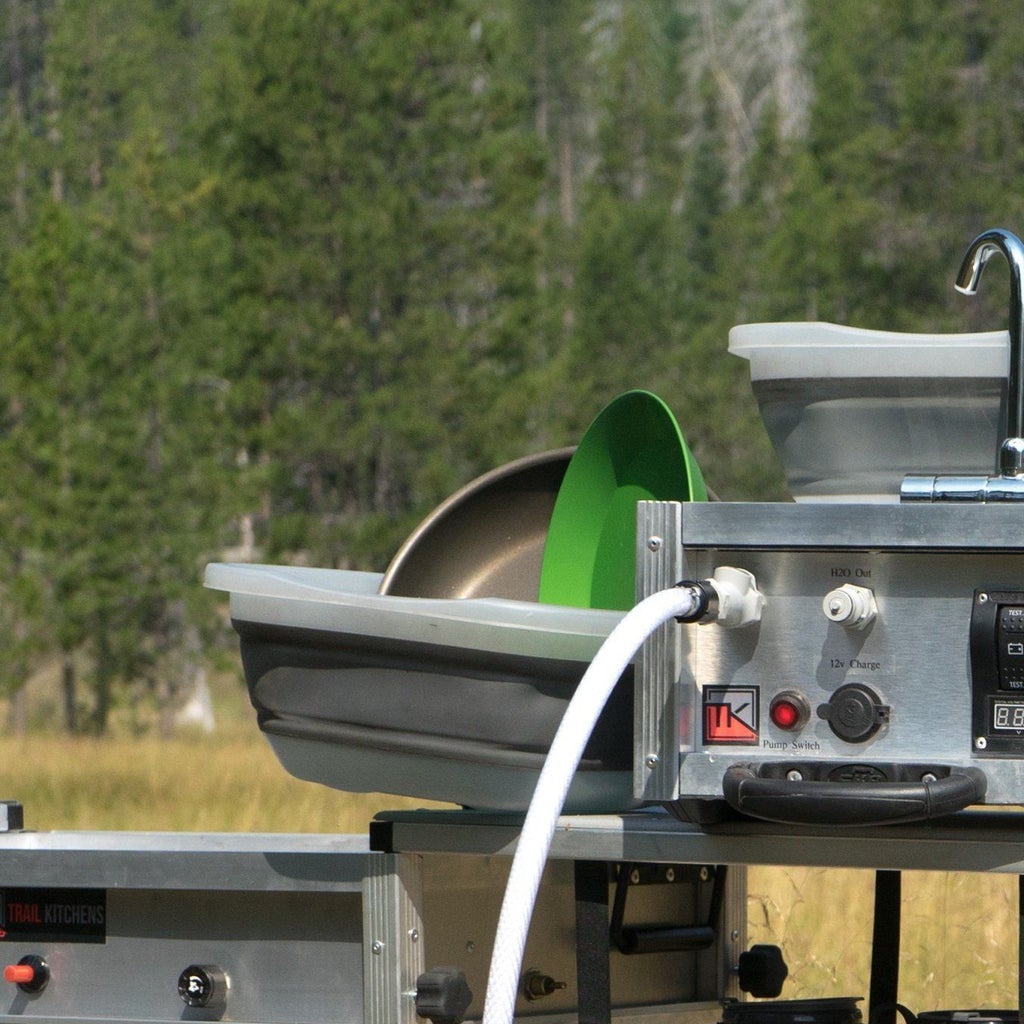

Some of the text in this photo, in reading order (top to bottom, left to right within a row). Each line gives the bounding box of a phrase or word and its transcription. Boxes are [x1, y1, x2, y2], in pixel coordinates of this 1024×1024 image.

[831, 568, 872, 578] H2O Out
[830, 660, 880, 671] 12v Charge
[763, 740, 820, 750] Pump Switch
[8, 902, 104, 924] TRAIL KITCHENS
